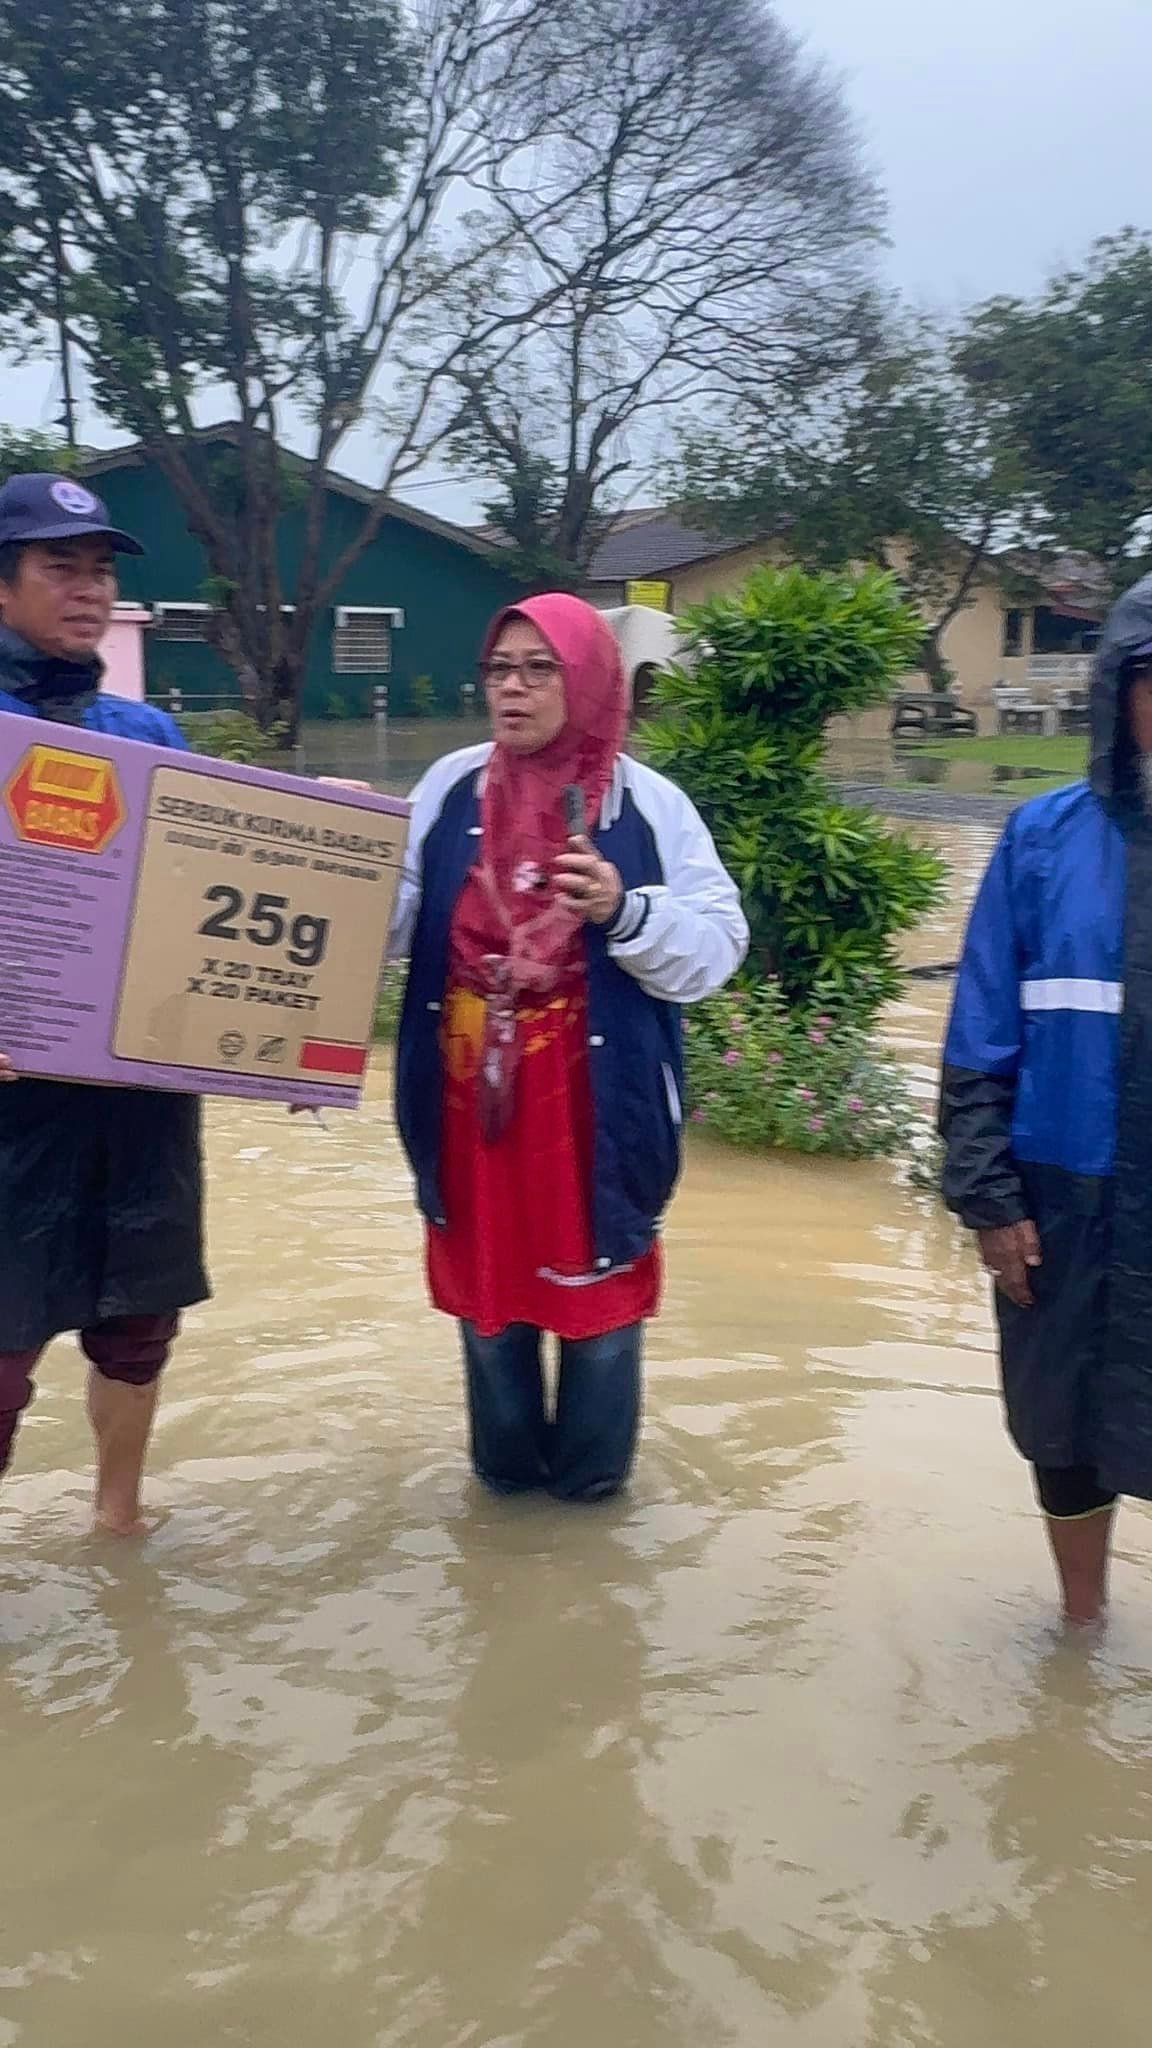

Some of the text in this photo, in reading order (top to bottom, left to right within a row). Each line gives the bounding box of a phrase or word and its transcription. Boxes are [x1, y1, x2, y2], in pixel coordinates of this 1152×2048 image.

[198, 884, 331, 967] 25g
[223, 961, 251, 980] 20
[255, 966, 315, 989] TRAY
[208, 981, 240, 999] 20
[243, 985, 322, 1011] PAKET
